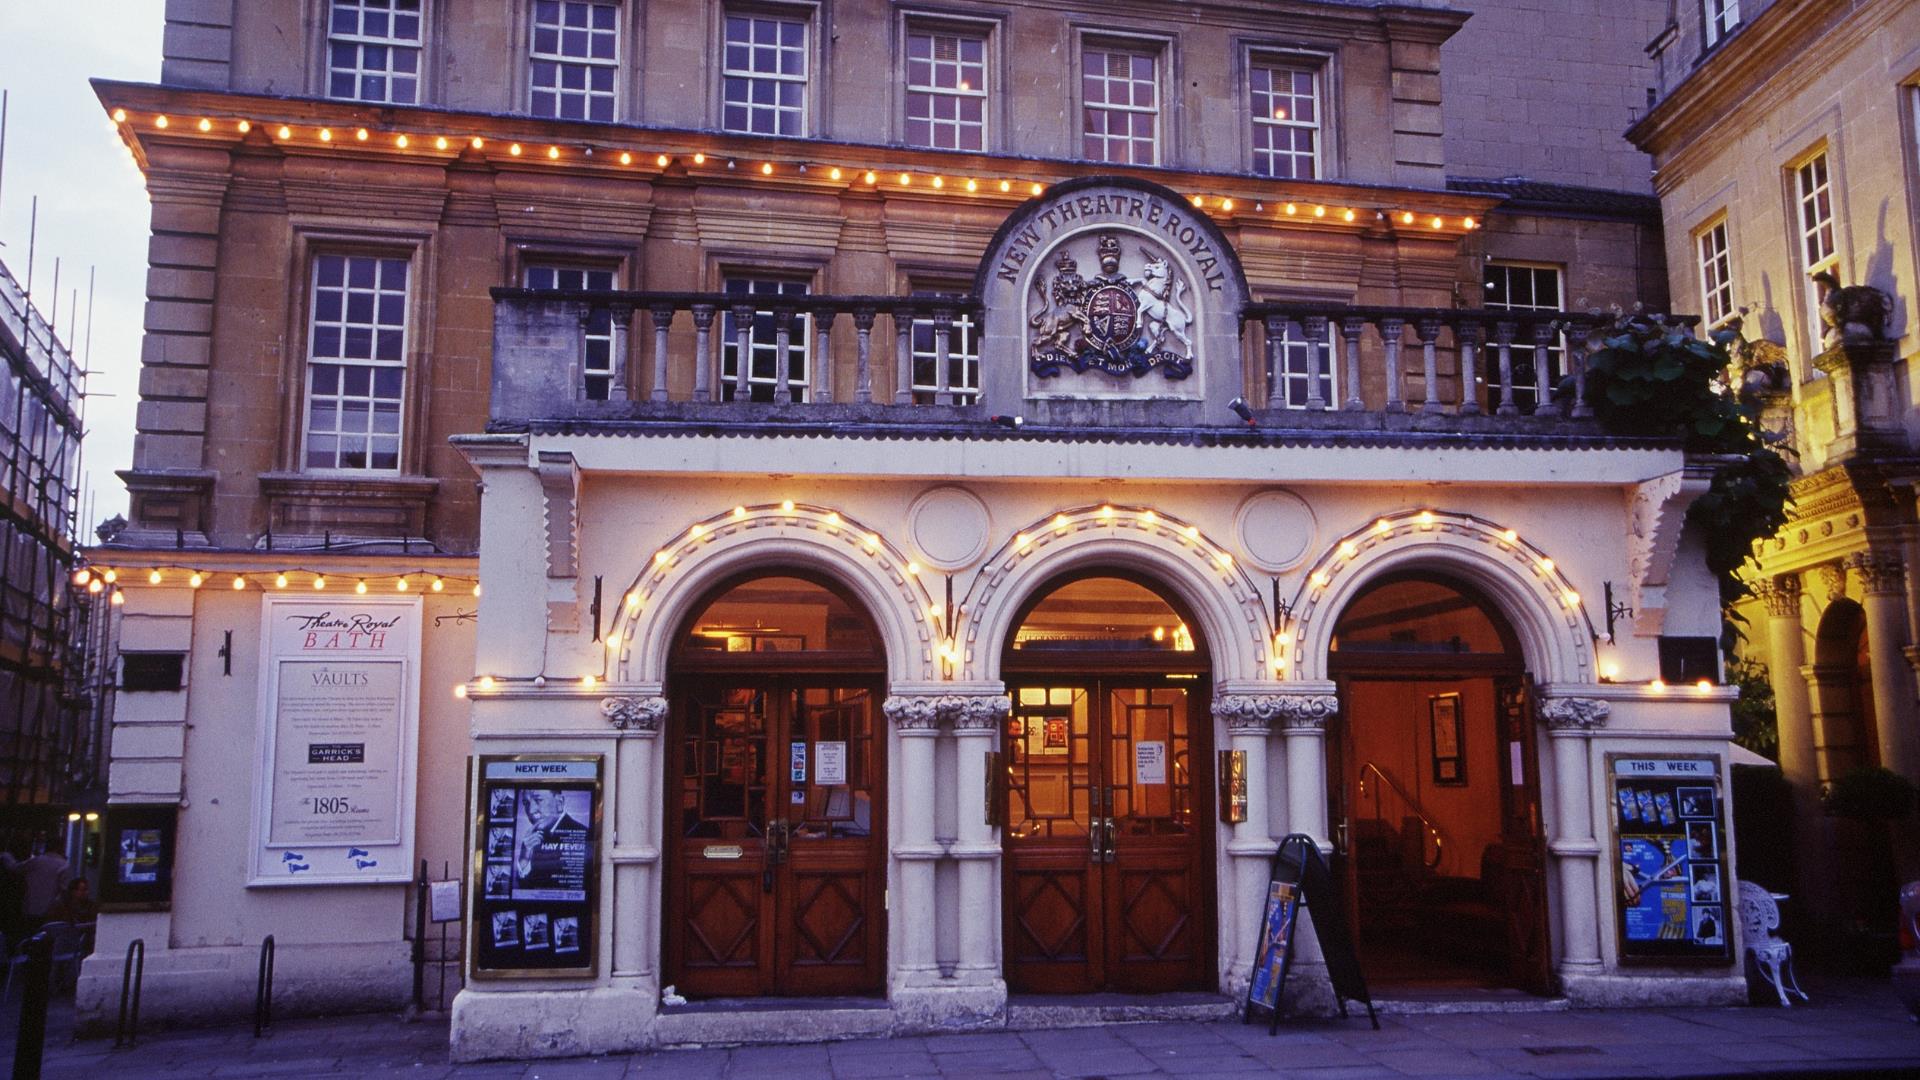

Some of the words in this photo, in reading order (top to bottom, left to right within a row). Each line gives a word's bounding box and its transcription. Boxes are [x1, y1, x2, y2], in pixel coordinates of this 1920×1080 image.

[997, 225, 1041, 284] NEW
[1038, 195, 1163, 231] THEATRE
[1163, 214, 1226, 292] ROYAL
[1148, 352, 1184, 367] DROIT
[287, 611, 348, 631] Theatre
[347, 613, 401, 635] Royal
[304, 632, 386, 649] BATH
[312, 673, 368, 686] VAULTS
[515, 764, 539, 773] NEXT
[541, 764, 568, 773] WEEK
[1631, 761, 1656, 771] THIS
[1666, 761, 1698, 772] WEEK
[313, 796, 349, 815] 1805
[541, 842, 558, 851] HAY
